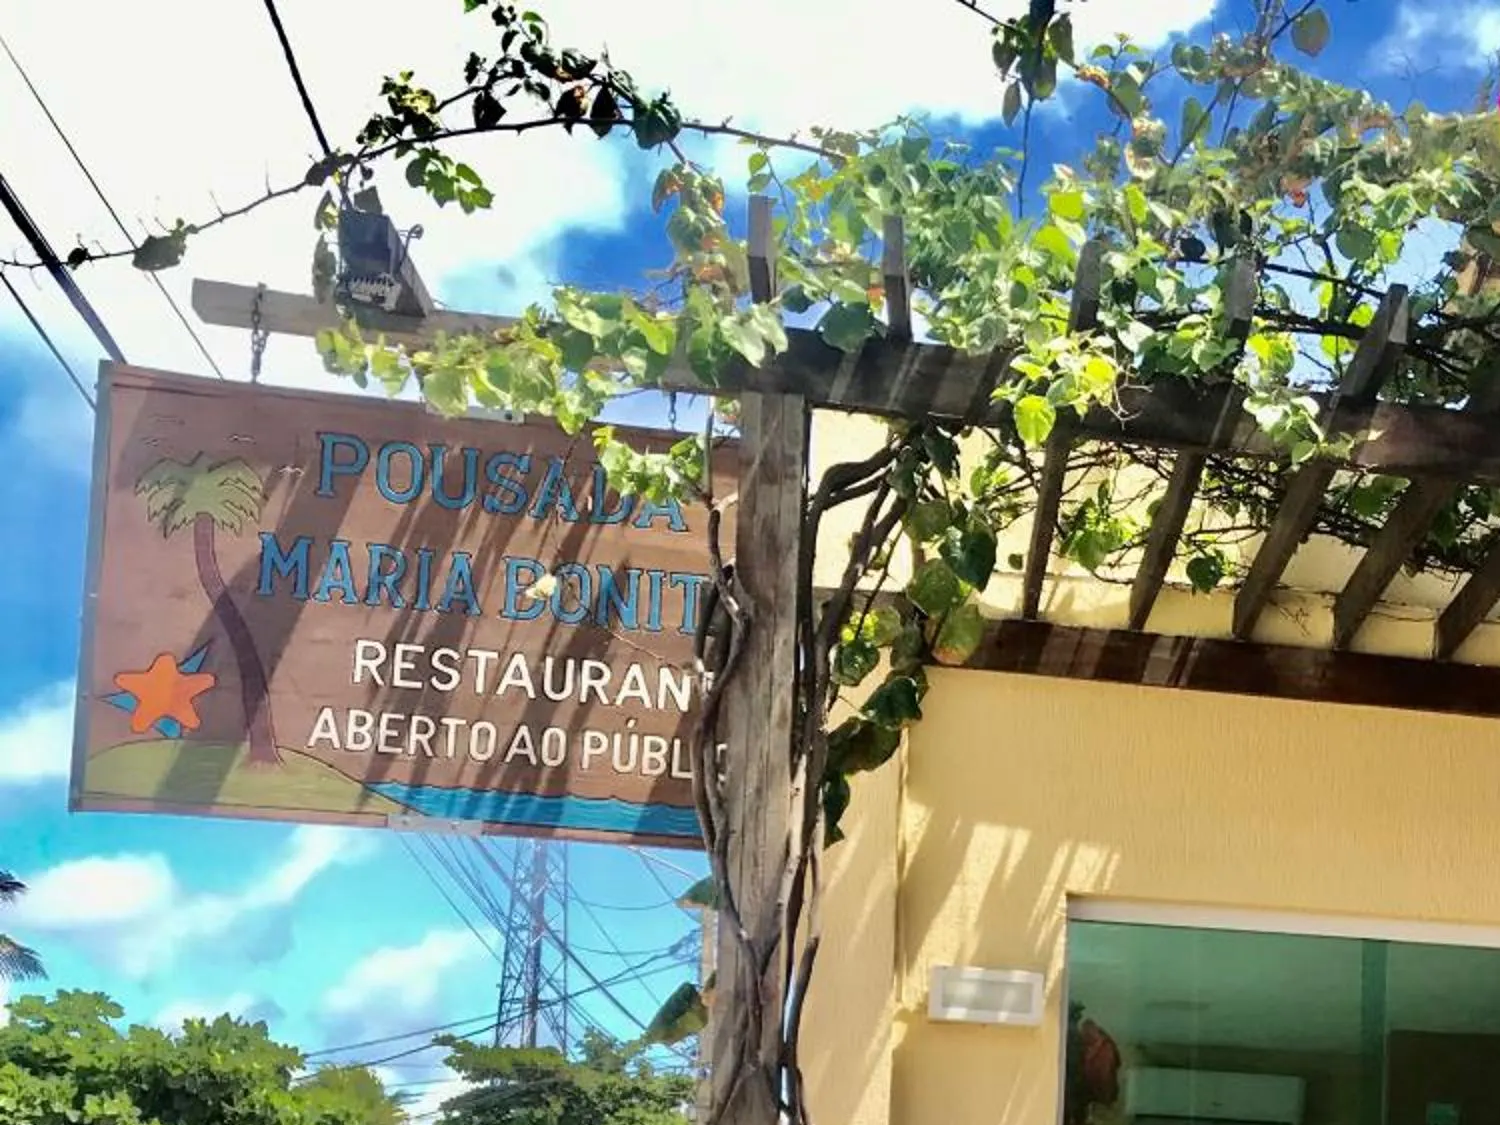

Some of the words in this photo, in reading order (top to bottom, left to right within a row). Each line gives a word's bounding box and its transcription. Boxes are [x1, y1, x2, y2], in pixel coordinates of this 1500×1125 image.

[256, 530, 482, 616] MARIA
[500, 555, 711, 635] BONIT
[352, 638, 714, 713] RESTAURAN
[305, 706, 498, 761] ABERTO
[504, 724, 567, 767] AO
[581, 718, 728, 784] PÚBL
